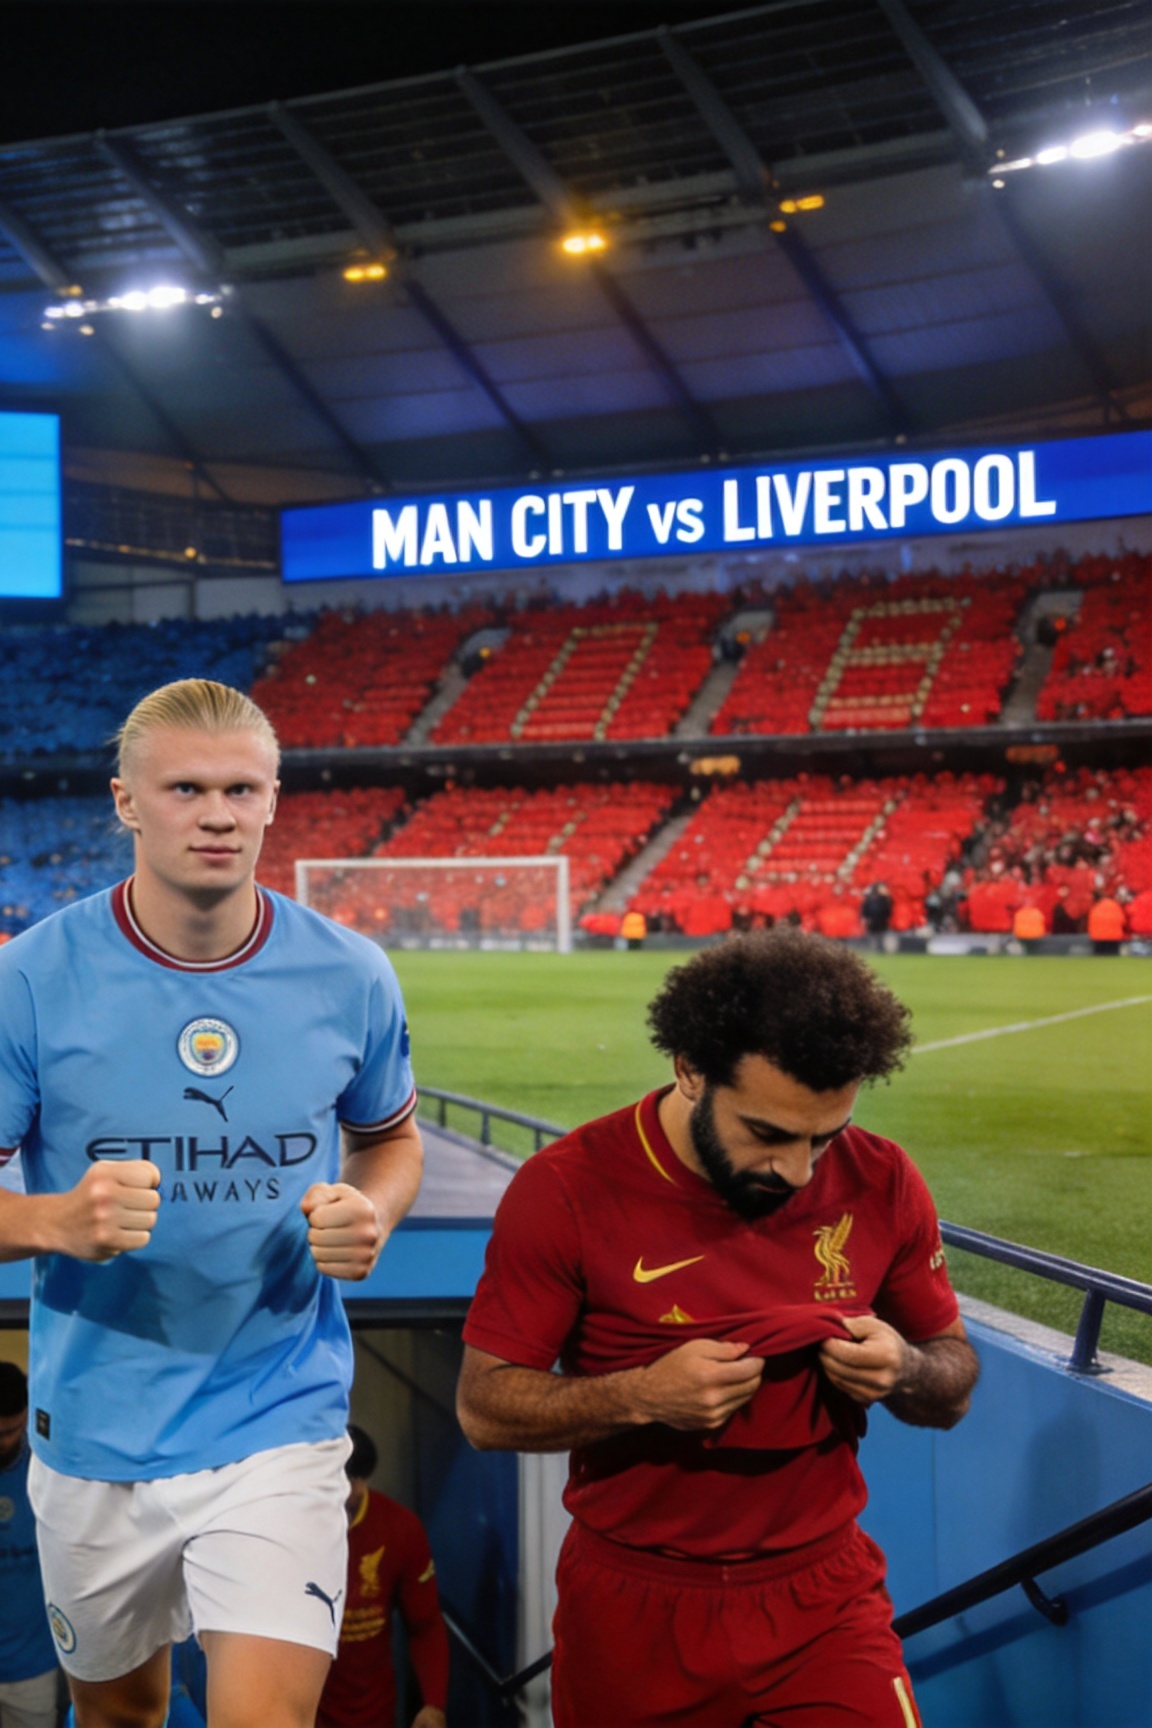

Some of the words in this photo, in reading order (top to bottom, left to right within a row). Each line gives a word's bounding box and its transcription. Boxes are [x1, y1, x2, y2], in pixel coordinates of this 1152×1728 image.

[372, 499, 494, 569] MAN
[511, 485, 635, 559] CITY
[723, 450, 1057, 543] LIVERPOOL
[86, 1132, 318, 1172] ETIHAD
